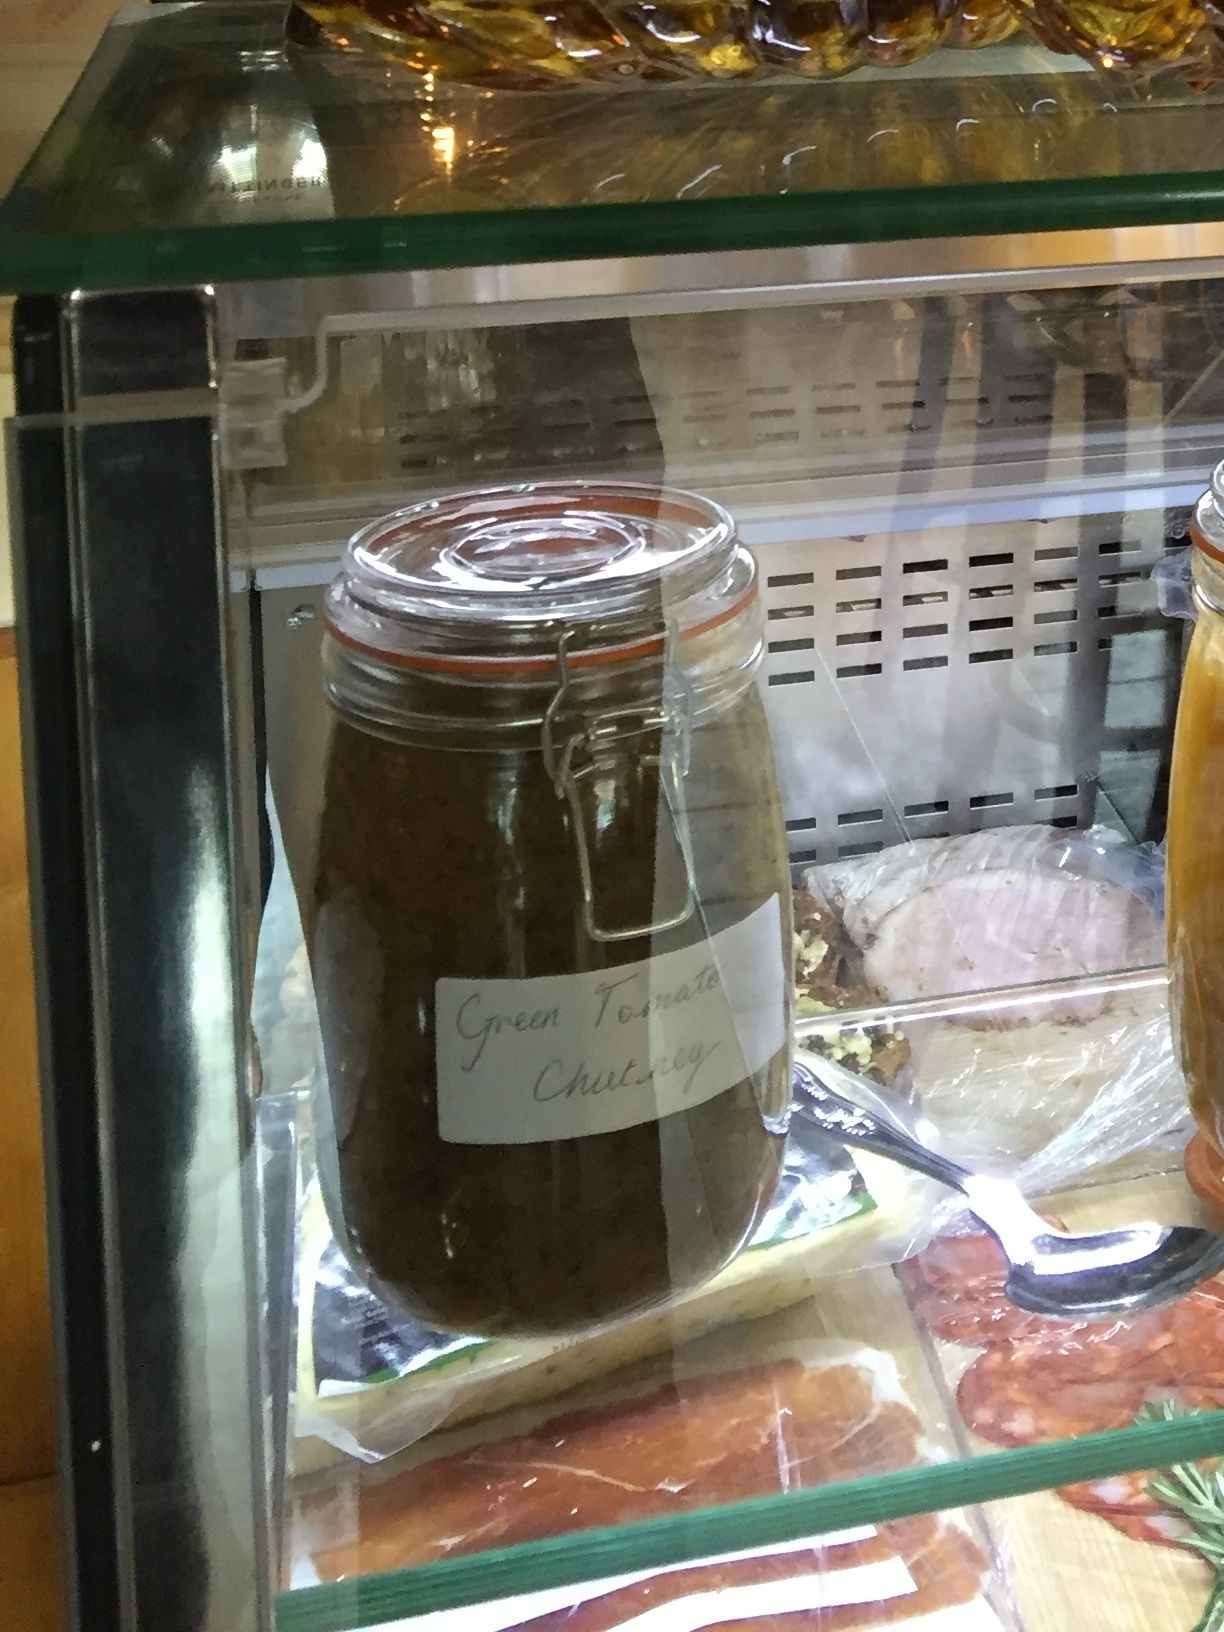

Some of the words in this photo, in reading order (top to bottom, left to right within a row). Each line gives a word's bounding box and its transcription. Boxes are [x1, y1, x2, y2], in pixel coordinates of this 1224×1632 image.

[456, 992, 560, 1073] Green
[593, 964, 722, 1030] Tomato
[533, 1039, 722, 1103] Chutney
